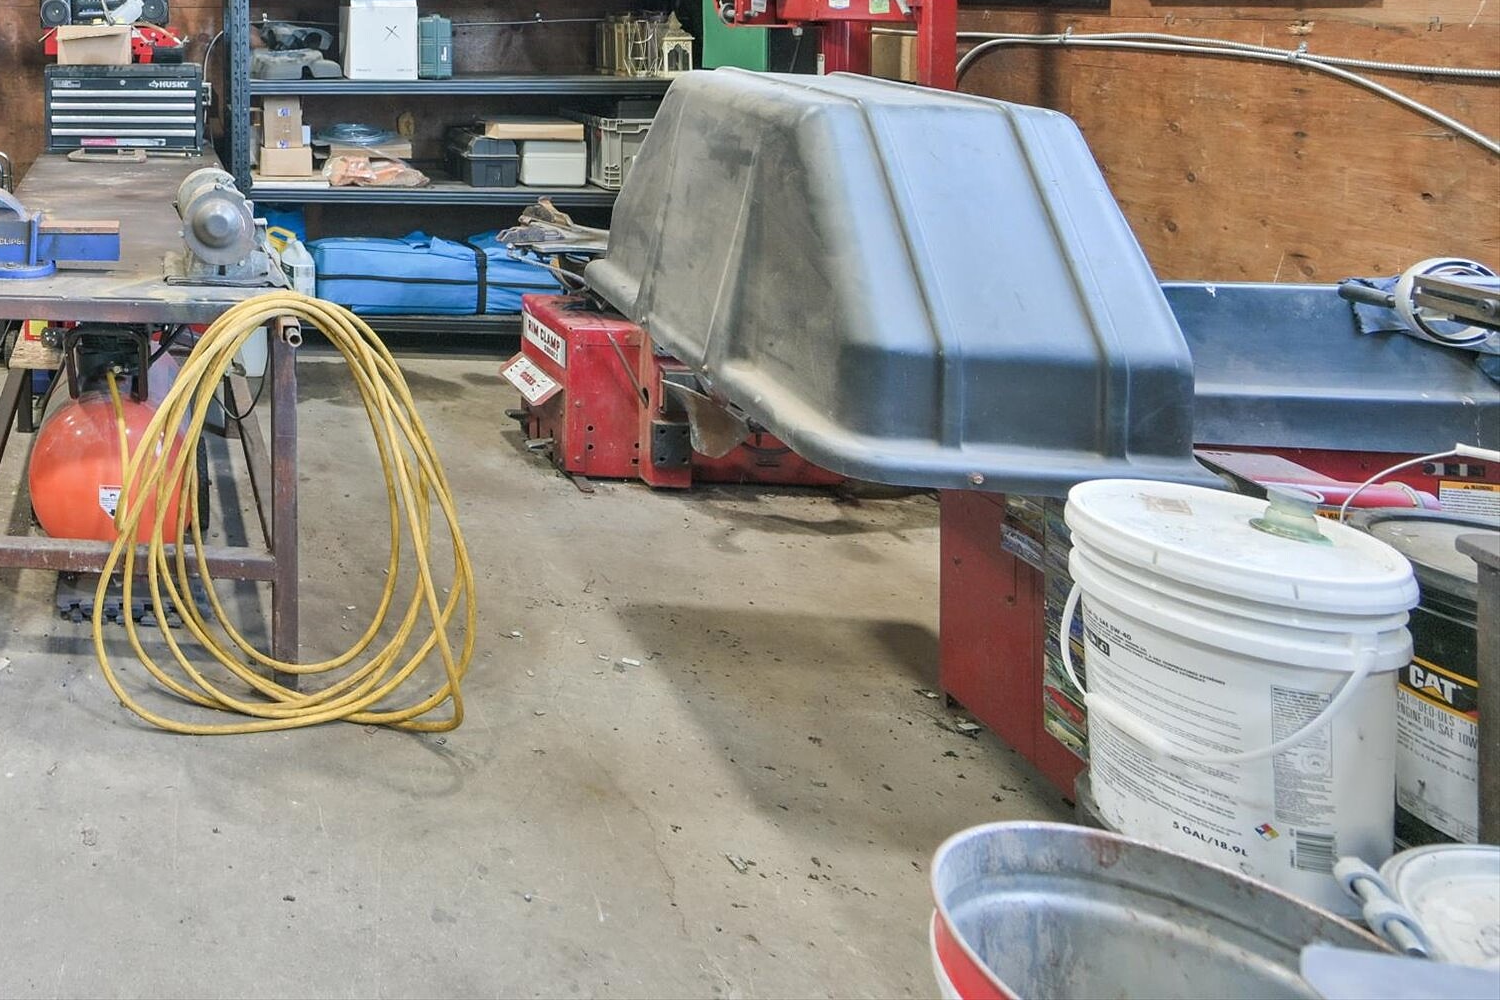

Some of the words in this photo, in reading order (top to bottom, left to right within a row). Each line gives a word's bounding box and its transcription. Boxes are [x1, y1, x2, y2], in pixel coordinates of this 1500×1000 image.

[159, 81, 189, 89] HUSKY
[528, 318, 539, 338] RIM
[540, 328, 561, 353] CLAMP
[1409, 664, 1457, 705] CAT
[1397, 702, 1422, 724] ENGINE
[1423, 716, 1435, 732] OIL
[1172, 820, 1180, 829] 5
[1181, 824, 1249, 857] GAL/18.9L
